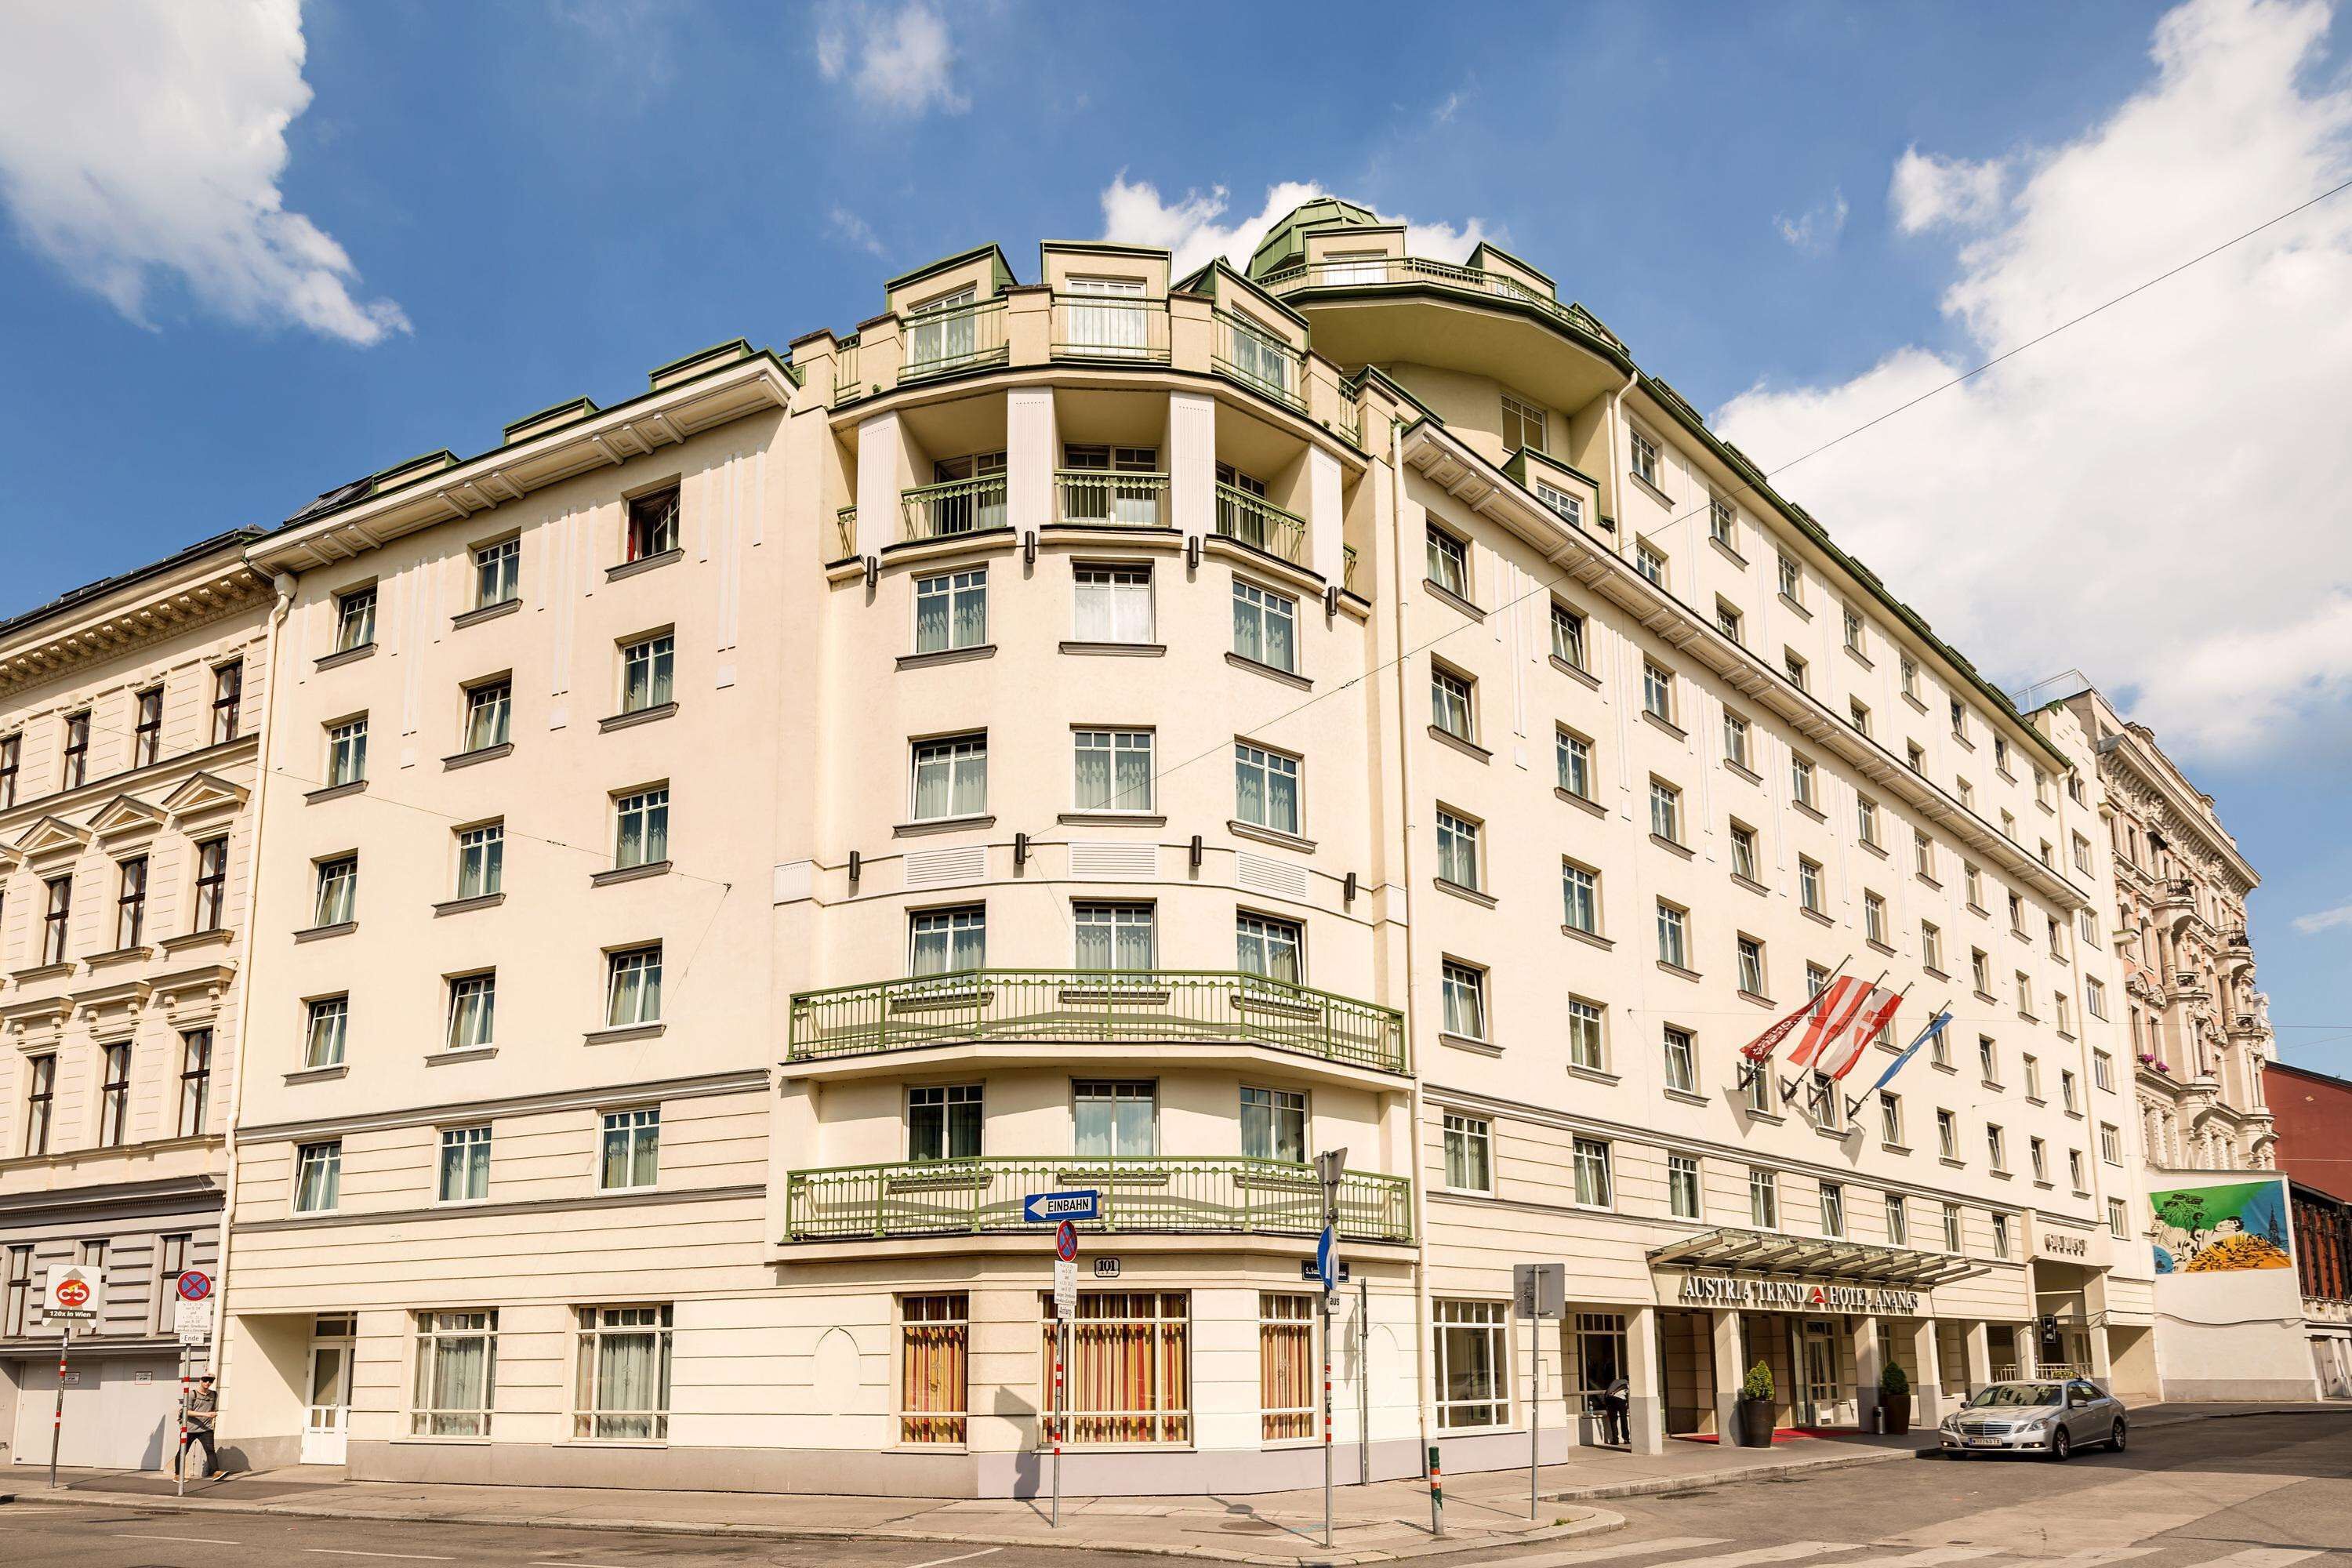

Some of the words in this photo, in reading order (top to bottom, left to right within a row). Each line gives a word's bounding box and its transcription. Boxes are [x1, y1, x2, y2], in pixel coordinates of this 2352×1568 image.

[1047, 1199, 1089, 1212] EINBAHN
[1098, 1260, 1116, 1272] 101
[1684, 1276, 1752, 1300] AUSTRIA
[1756, 1281, 1805, 1303] TREND
[1829, 1286, 1872, 1306] HOTEL
[1875, 1290, 1918, 1308] ANANAS
